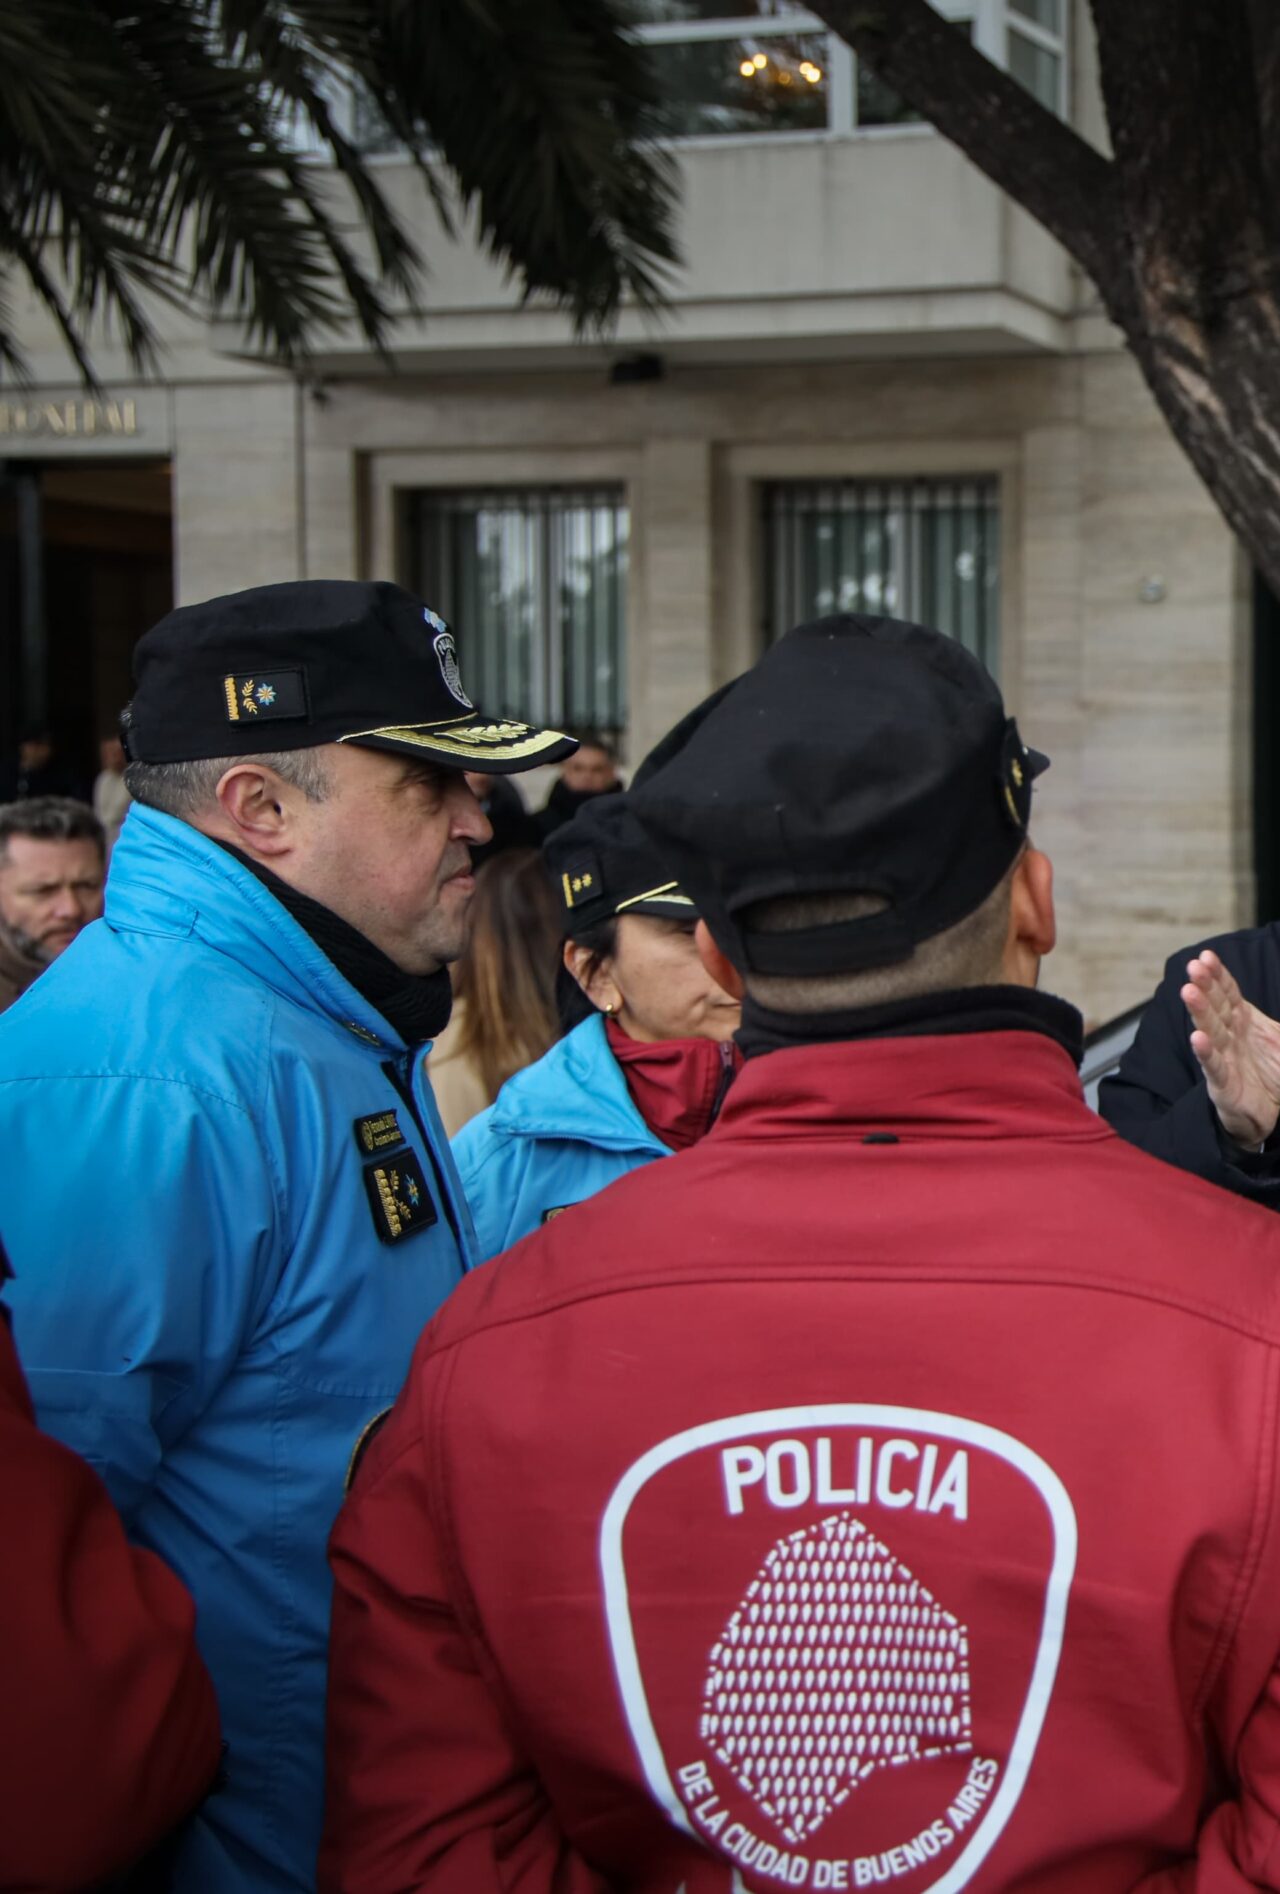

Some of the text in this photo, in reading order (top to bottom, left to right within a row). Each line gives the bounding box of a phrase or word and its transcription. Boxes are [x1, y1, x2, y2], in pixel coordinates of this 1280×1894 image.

[722, 1437, 968, 1520] POLICIA
[679, 1757, 998, 1889] DE LA CIUDAD DE BUENOS AIRES
